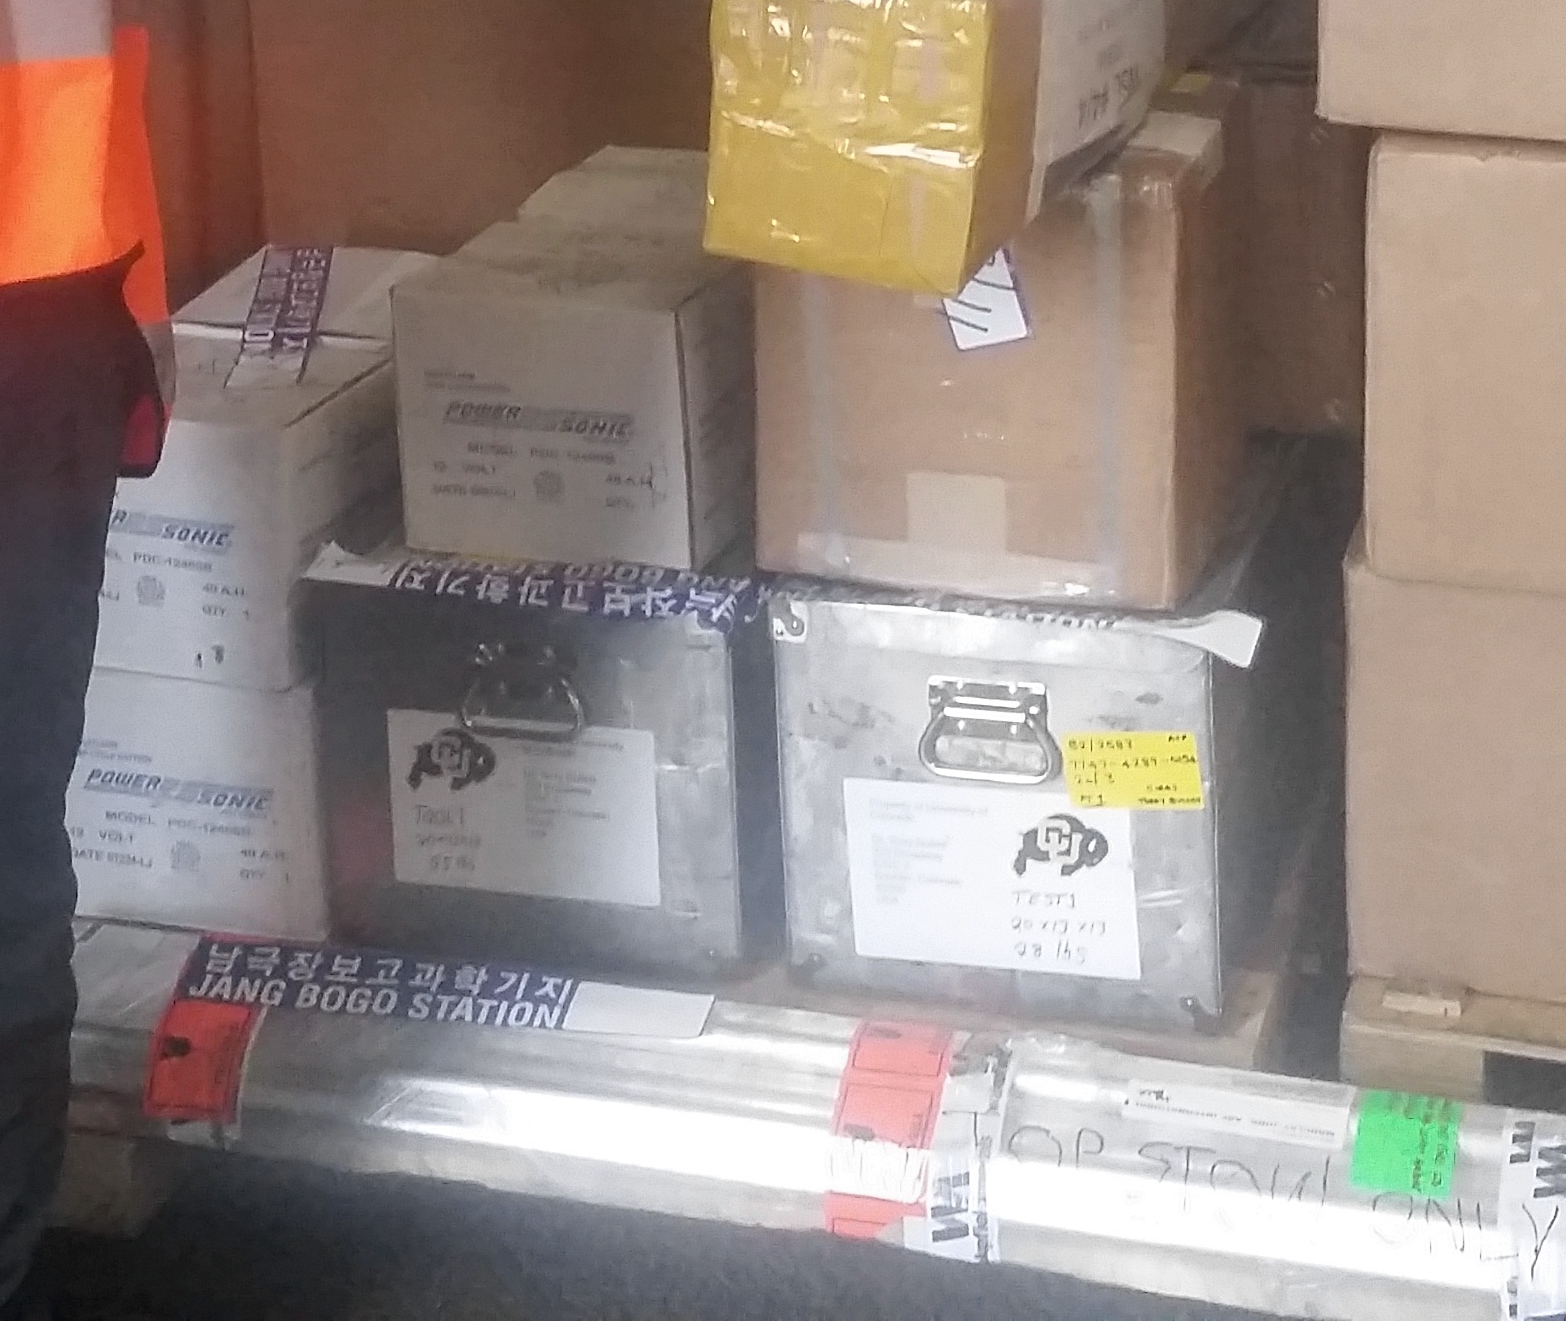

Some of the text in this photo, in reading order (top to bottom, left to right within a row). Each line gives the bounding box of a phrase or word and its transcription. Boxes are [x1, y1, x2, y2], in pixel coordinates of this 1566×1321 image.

[162, 525, 230, 546] SONIC
[86, 768, 162, 790] POWER
[205, 944, 574, 1005] 남극장보고과학기지
[188, 975, 564, 1029] JANG BOGO STATION
